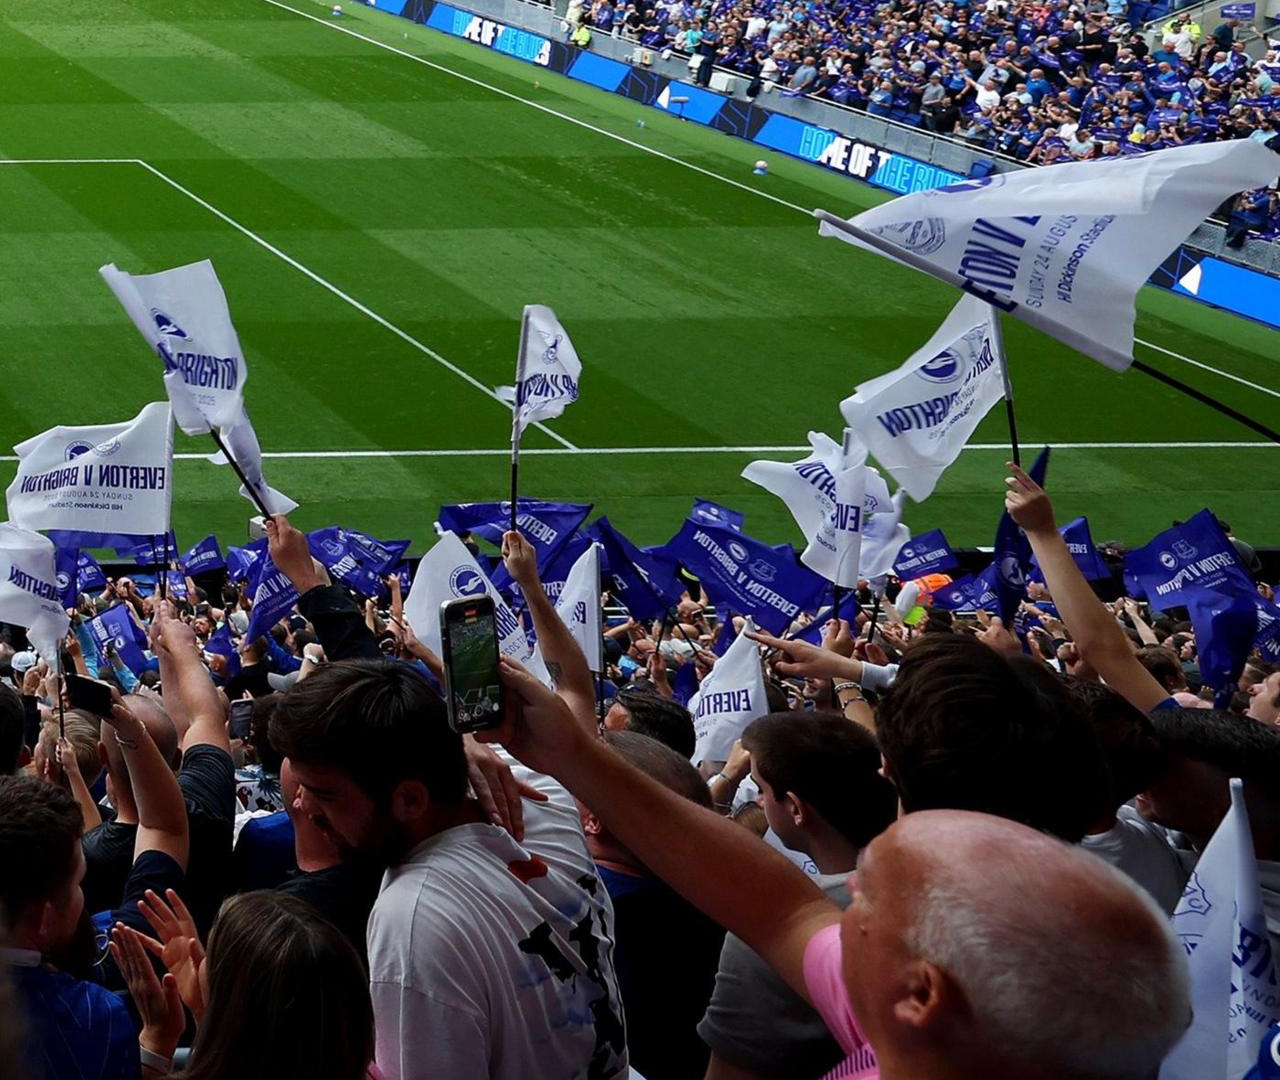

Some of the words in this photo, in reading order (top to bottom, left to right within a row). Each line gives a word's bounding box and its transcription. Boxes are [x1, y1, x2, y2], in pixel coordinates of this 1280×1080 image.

[800, 125, 850, 170] HOME
[848, 143, 876, 178] OF
[875, 150, 913, 193] THE
